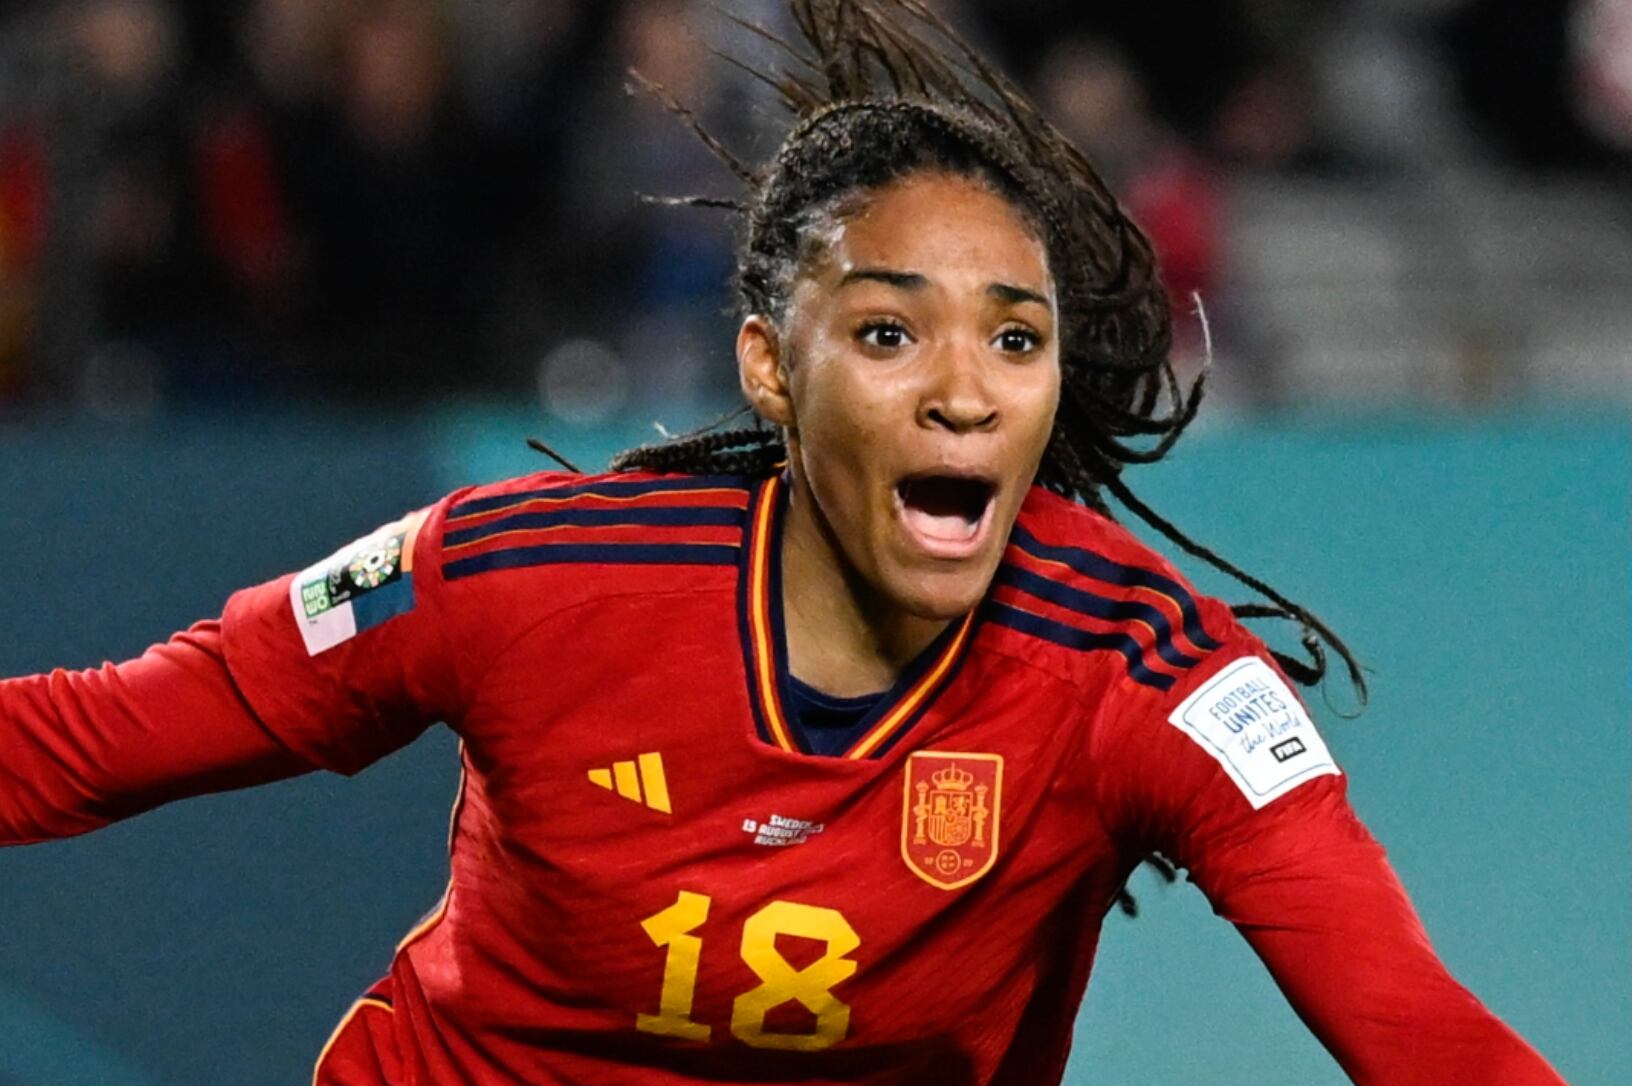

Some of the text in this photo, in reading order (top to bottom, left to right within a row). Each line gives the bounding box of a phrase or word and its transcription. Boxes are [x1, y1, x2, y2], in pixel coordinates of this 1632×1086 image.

[1209, 677, 1270, 720] FOOTBALL
[1223, 691, 1287, 733] UNITES
[635, 890, 861, 1051] 18
